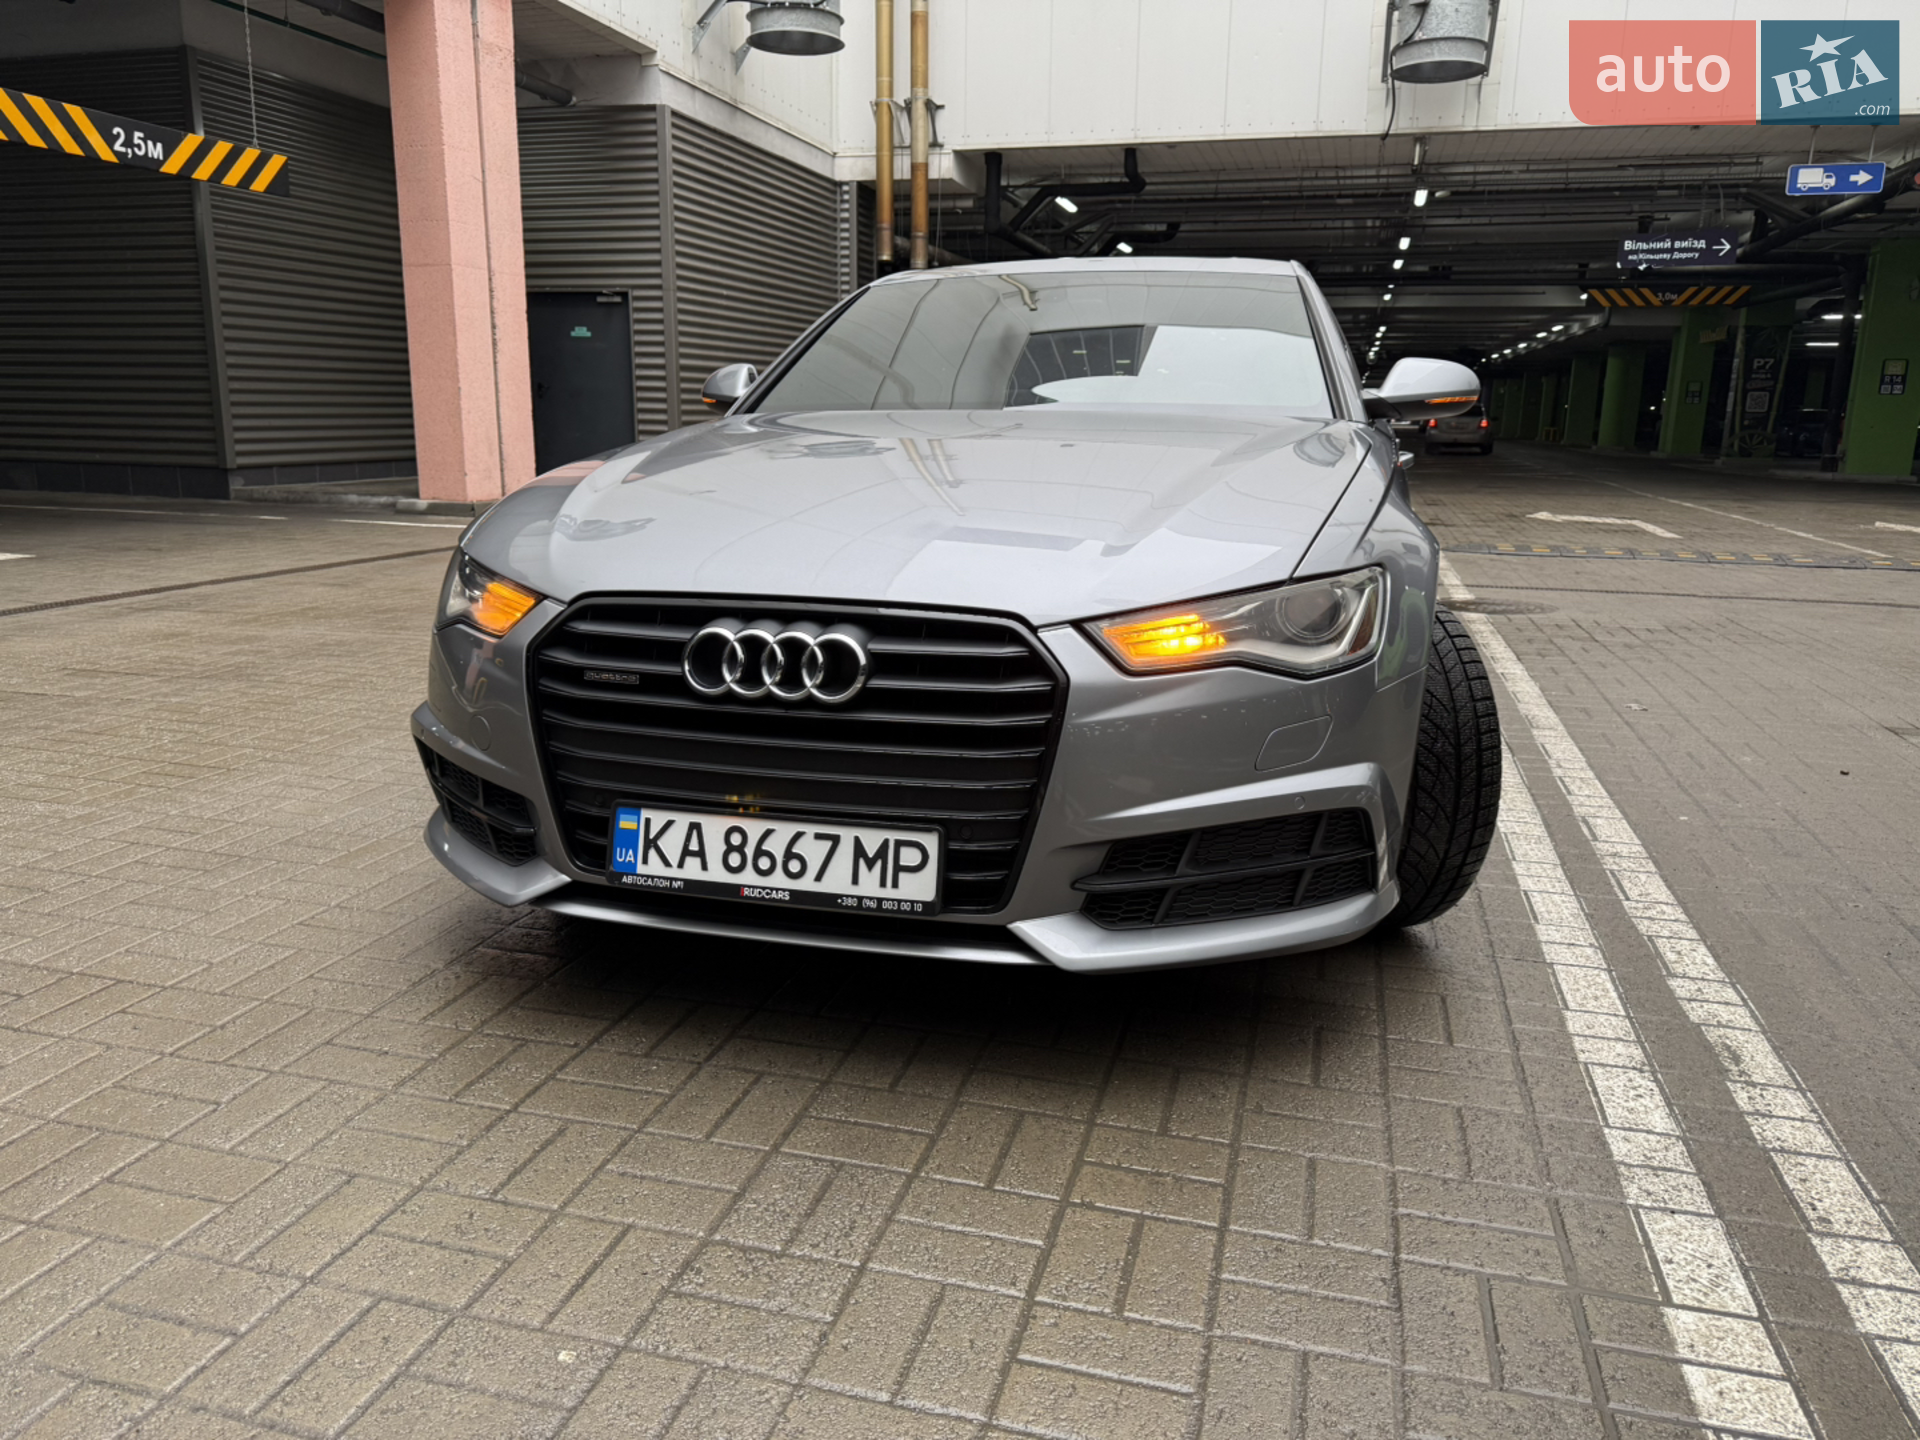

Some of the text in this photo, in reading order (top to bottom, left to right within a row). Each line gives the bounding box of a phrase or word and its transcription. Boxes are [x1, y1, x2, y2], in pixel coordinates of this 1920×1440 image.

[1624, 237, 1706, 251] Вільний виїзд
[1672, 251, 1701, 260] Дорогу
[1752, 358, 1775, 370] P7
[616, 846, 636, 864] UA
[641, 816, 930, 889] KA 8667 MP
[621, 875, 671, 888] АВТОСАЛОН
[837, 897, 923, 912] +380 (96) 003 00 10
